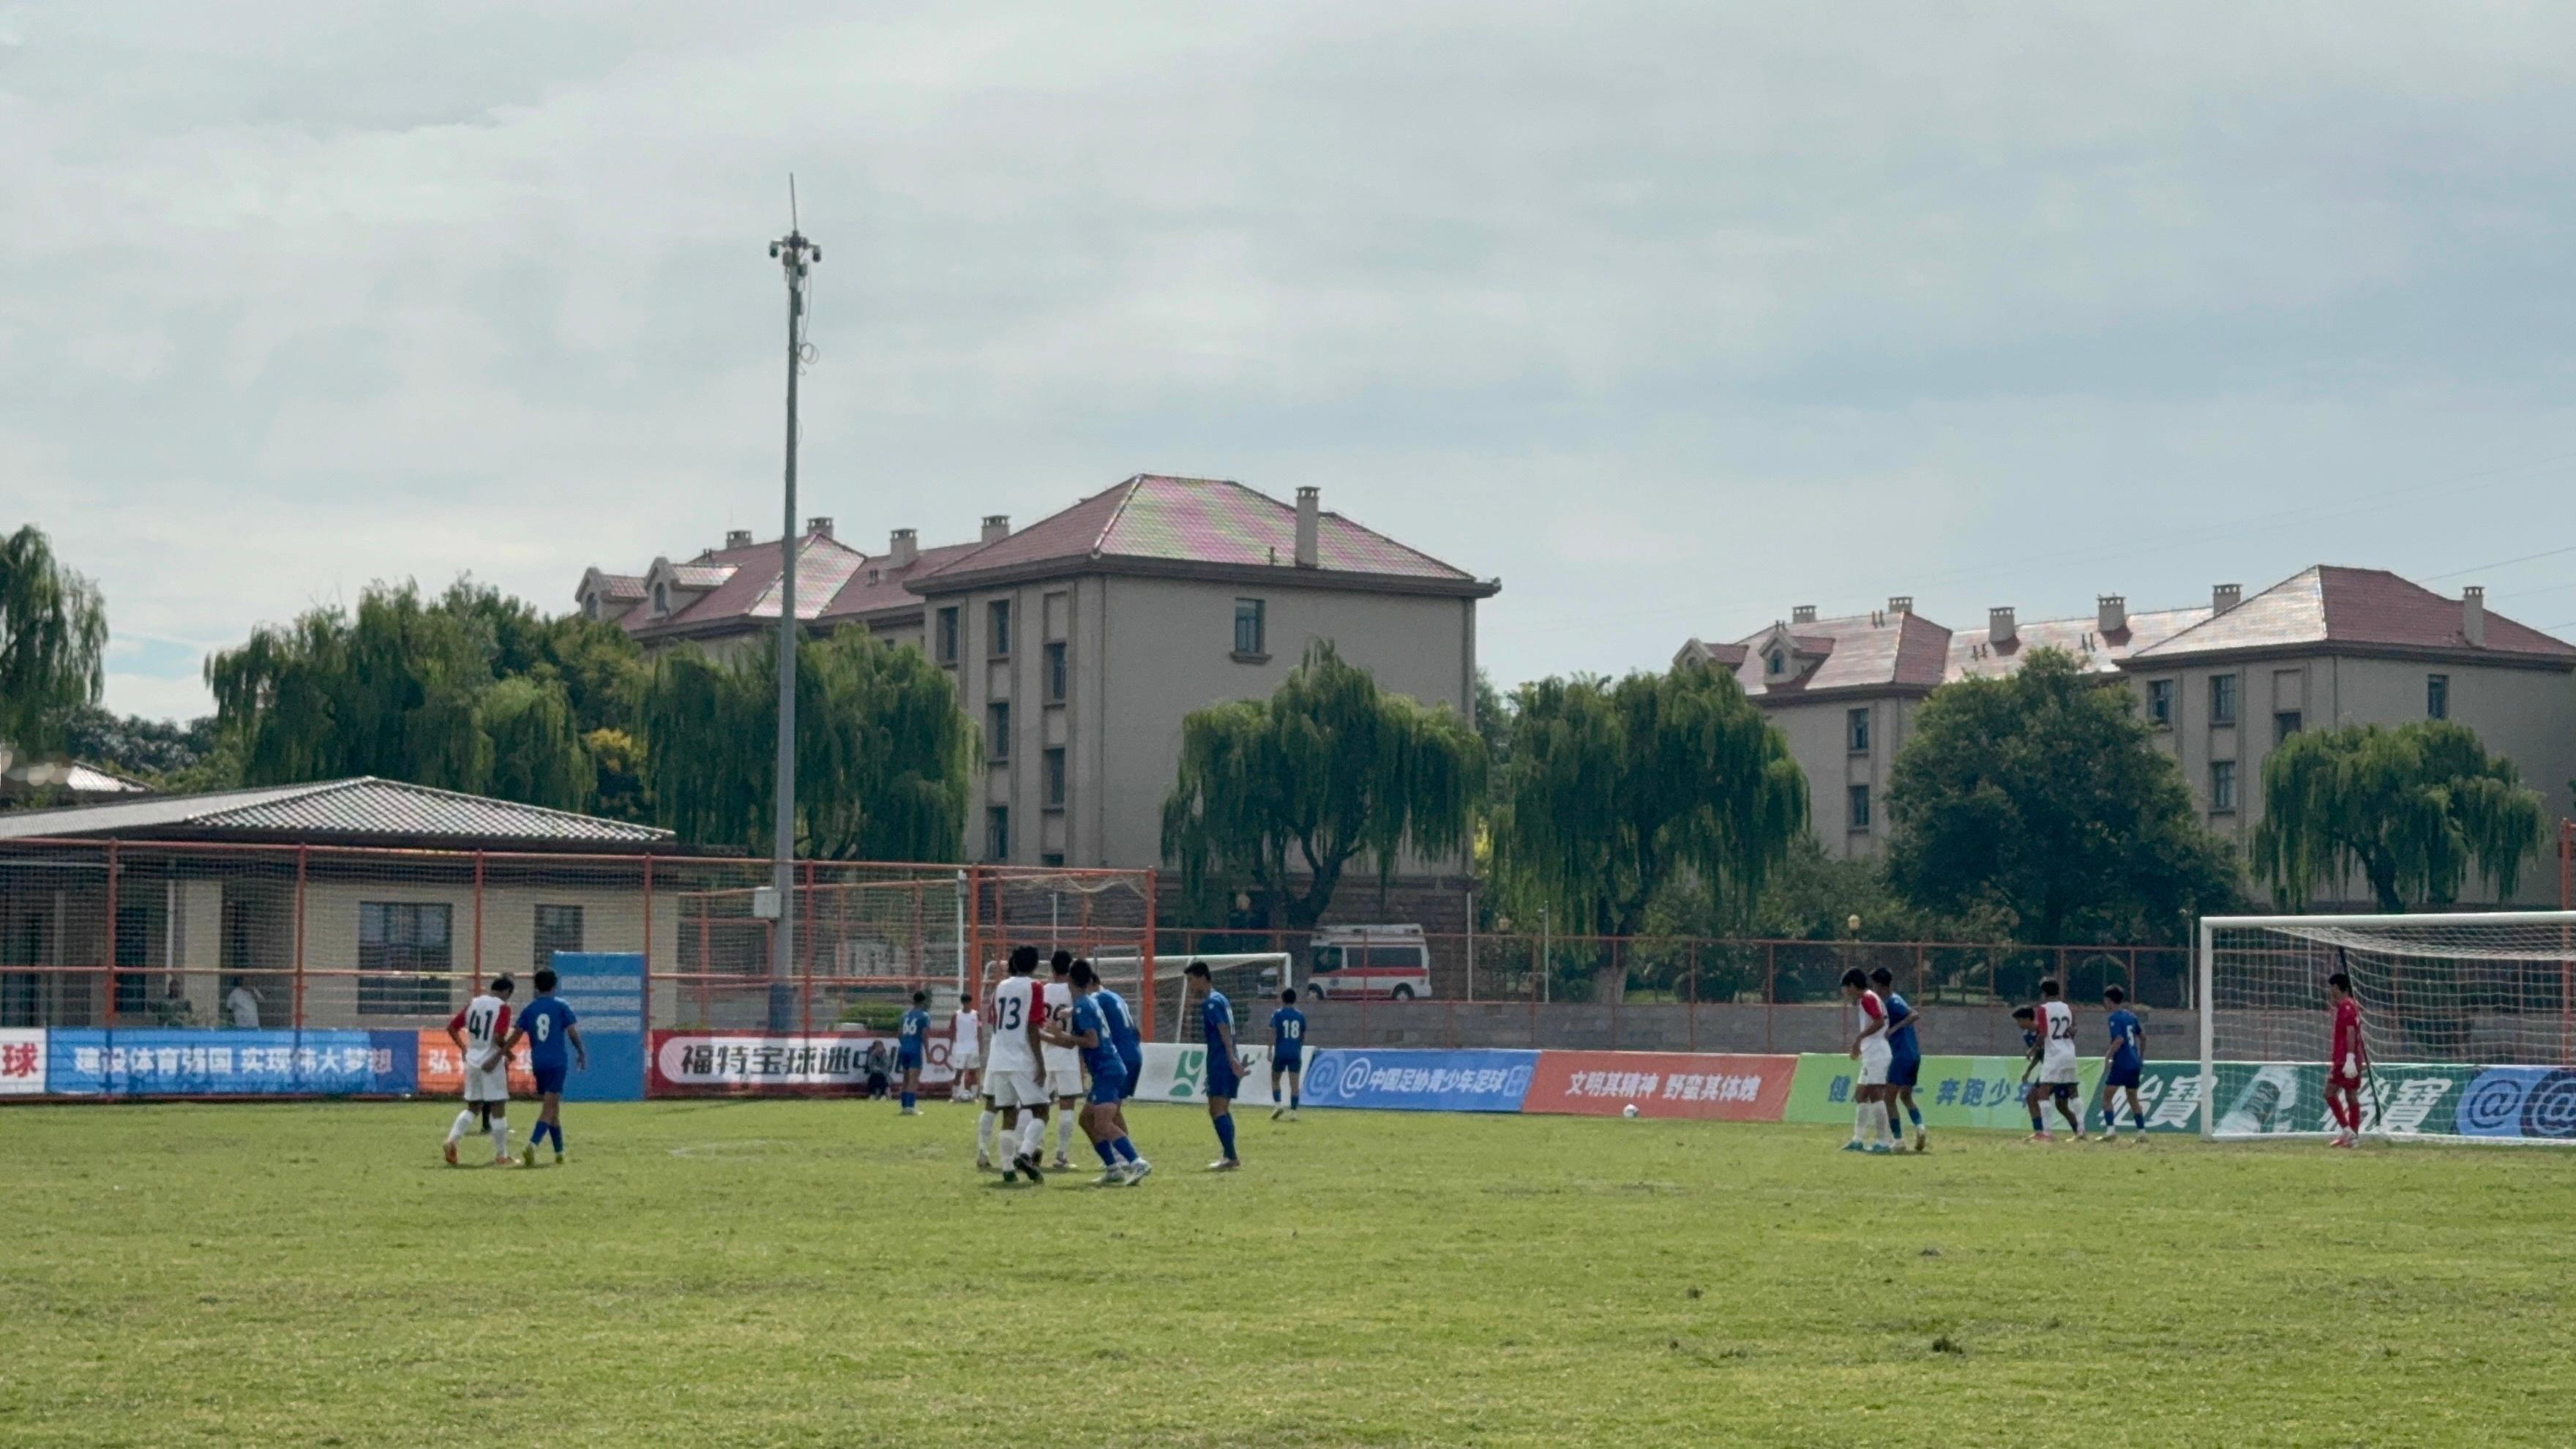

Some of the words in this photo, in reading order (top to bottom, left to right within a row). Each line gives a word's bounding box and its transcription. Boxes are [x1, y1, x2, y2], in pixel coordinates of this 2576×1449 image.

[468, 1009, 493, 1041] 41
[536, 1013, 550, 1042] 8
[998, 997, 1022, 1030] 13
[1282, 1019, 1300, 1038] 18
[1, 1042, 38, 1077] 球
[75, 1046, 233, 1075] 建设体育强国
[242, 1046, 393, 1074] 实现伟大梦想
